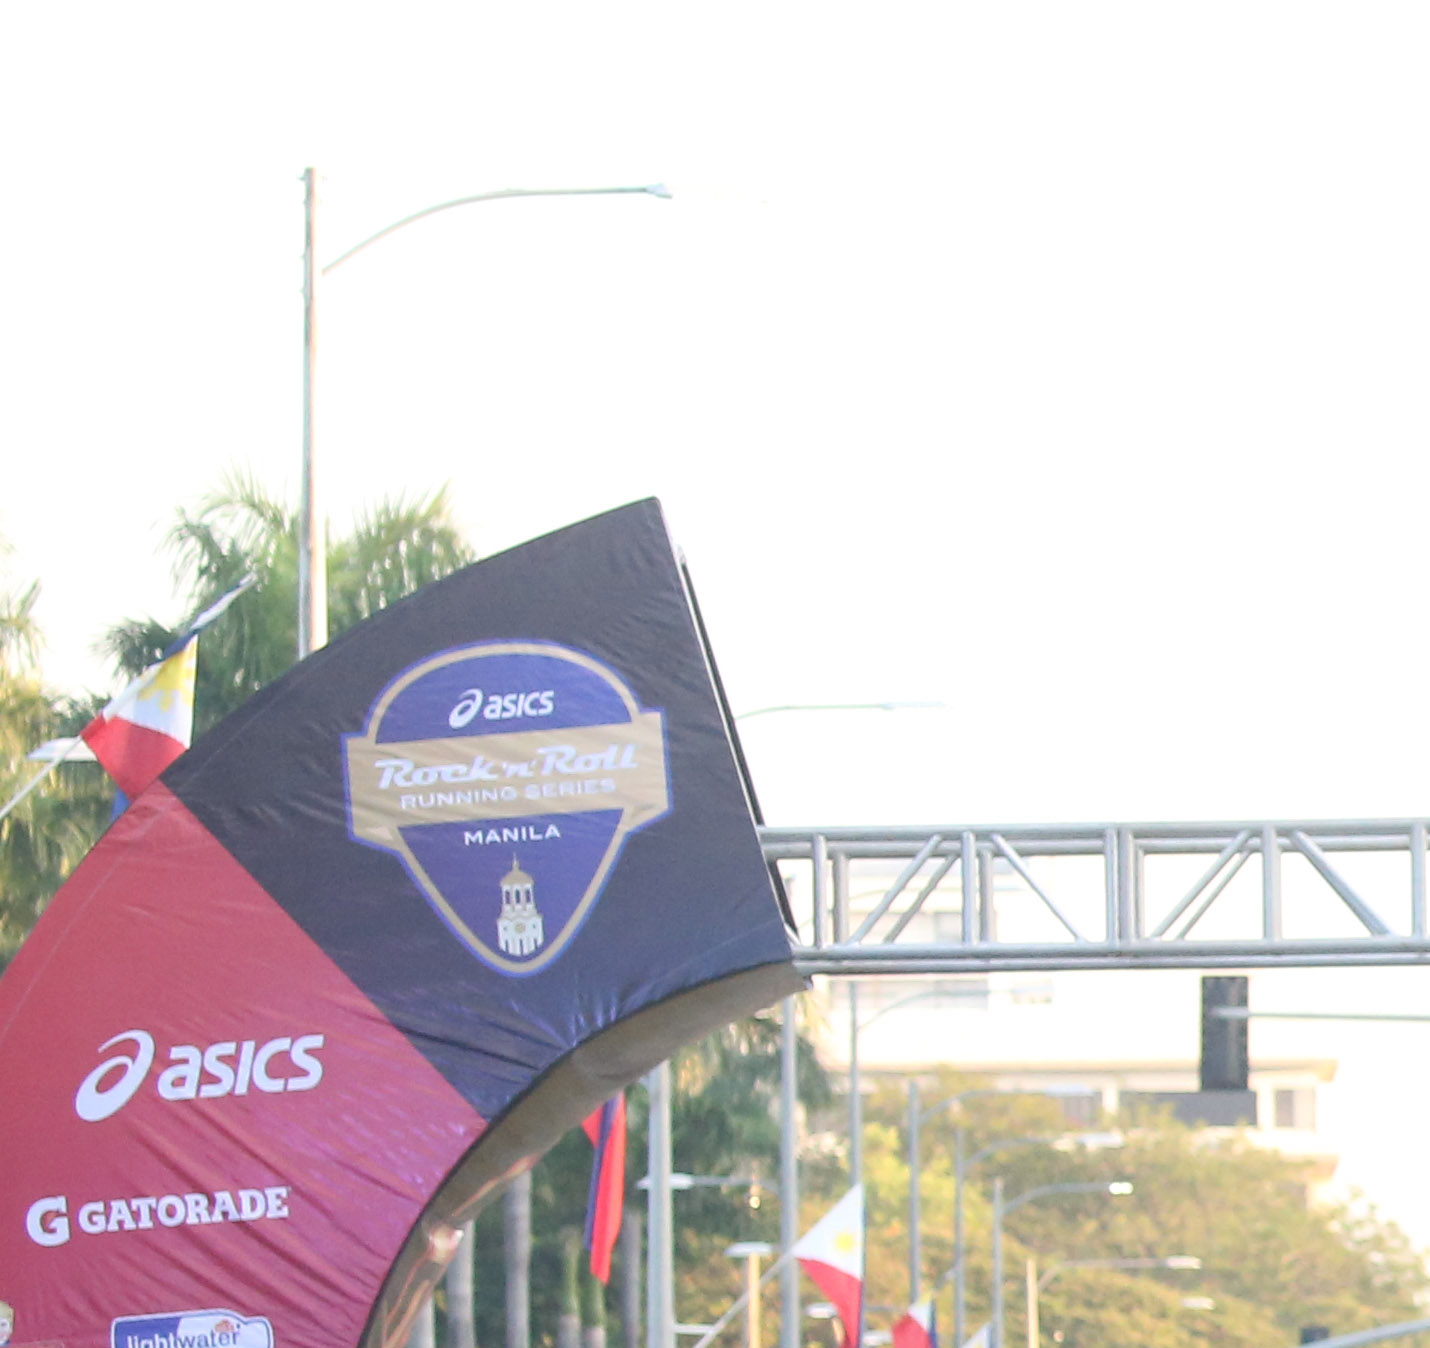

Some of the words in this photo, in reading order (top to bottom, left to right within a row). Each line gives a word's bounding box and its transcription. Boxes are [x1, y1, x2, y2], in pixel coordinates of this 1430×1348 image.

[482, 690, 555, 720] asics
[374, 755, 499, 790] Rock
[537, 743, 640, 777] Roll
[400, 785, 518, 811] RUNNING
[525, 777, 617, 800] SERIES
[463, 823, 562, 847] MANILA
[157, 1034, 325, 1102] asics
[78, 1186, 290, 1235] GATORADE
